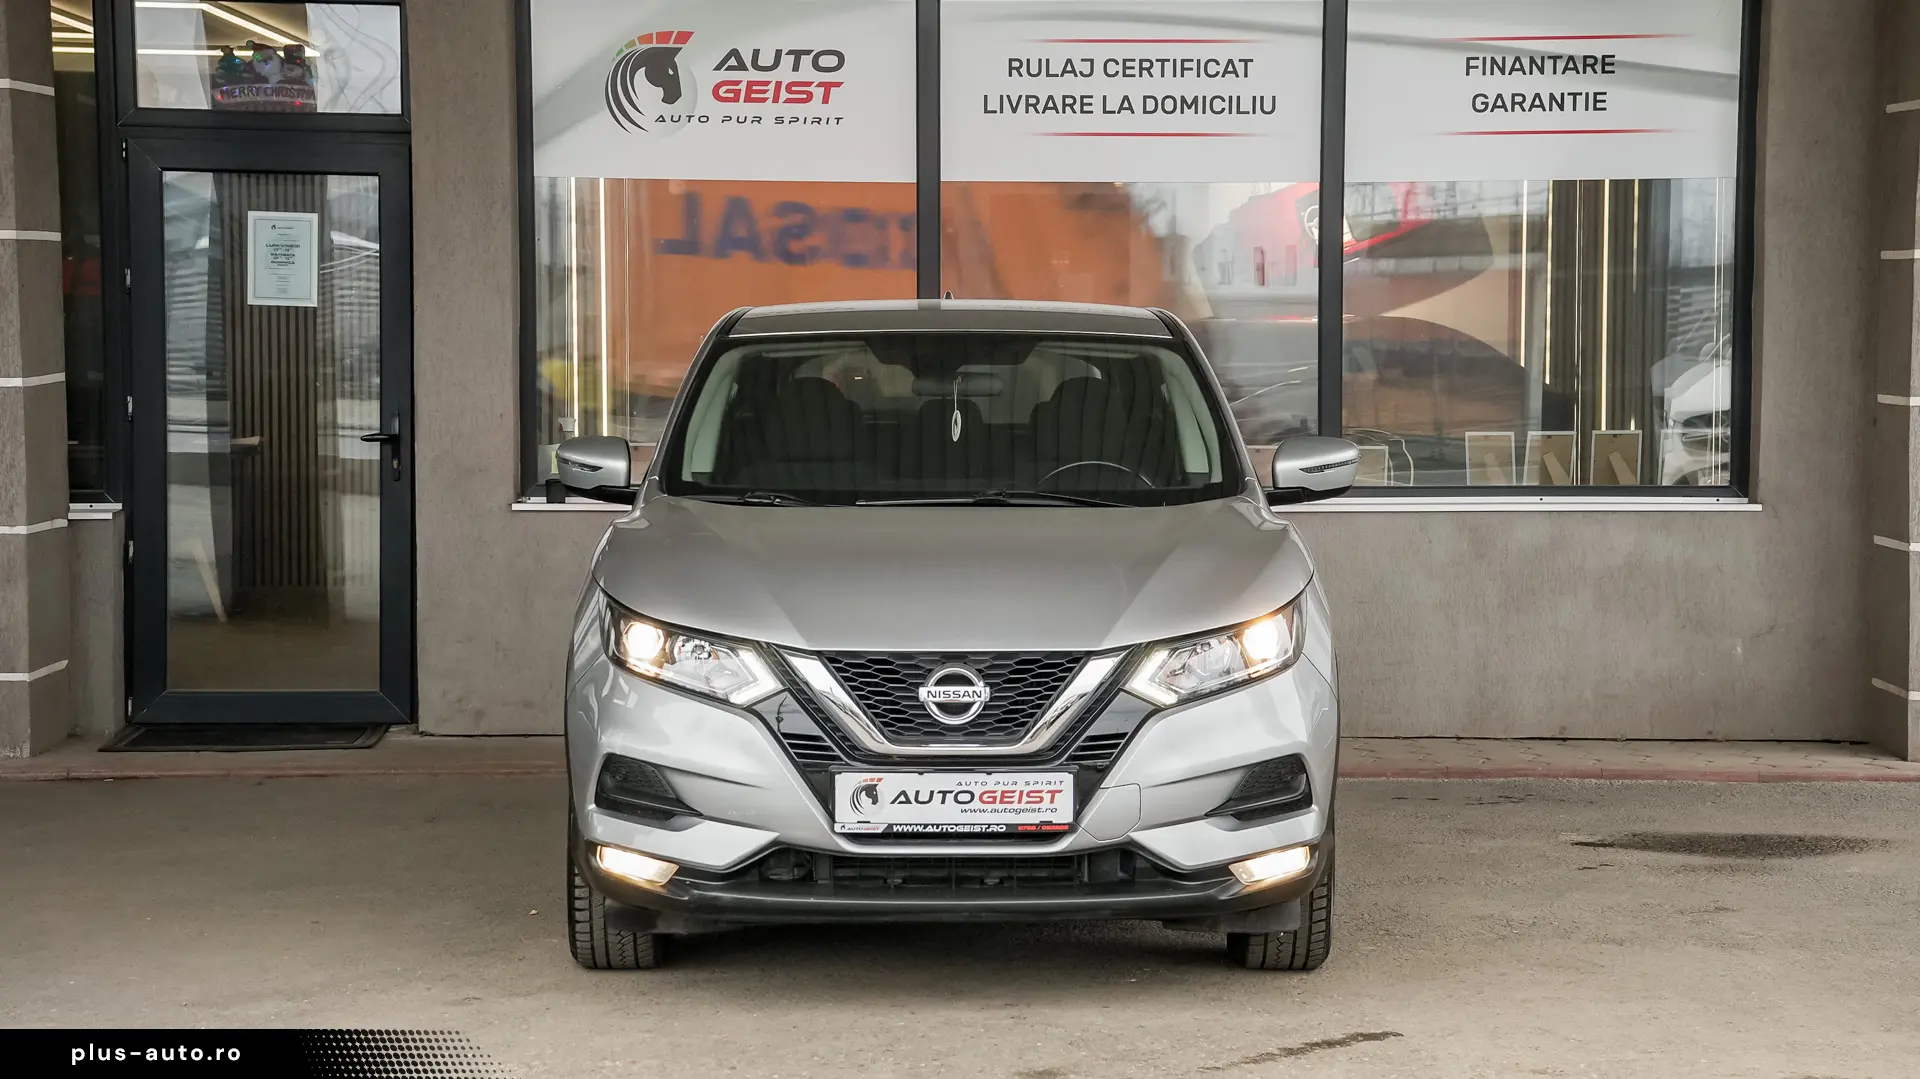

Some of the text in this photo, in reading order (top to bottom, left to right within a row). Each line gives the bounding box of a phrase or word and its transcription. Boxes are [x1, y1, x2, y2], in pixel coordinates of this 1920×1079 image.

[713, 48, 846, 73] AUTO
[1008, 57, 1254, 79] RULAJ CERTIFICAT
[1465, 54, 1616, 77] FINANTARE
[220, 86, 261, 99] MERRY
[711, 80, 845, 105] GEIST
[1471, 92, 1608, 113] GARANTIE
[983, 94, 1277, 115] LIVRARE LA DOMICILIU
[654, 115, 845, 126] AUTO PUR SPIRIT
[926, 690, 982, 699] NISSAN
[960, 806, 1058, 815] www.autogeist.ro
[893, 824, 1007, 833] WWW.AUTOGEIST.RO
